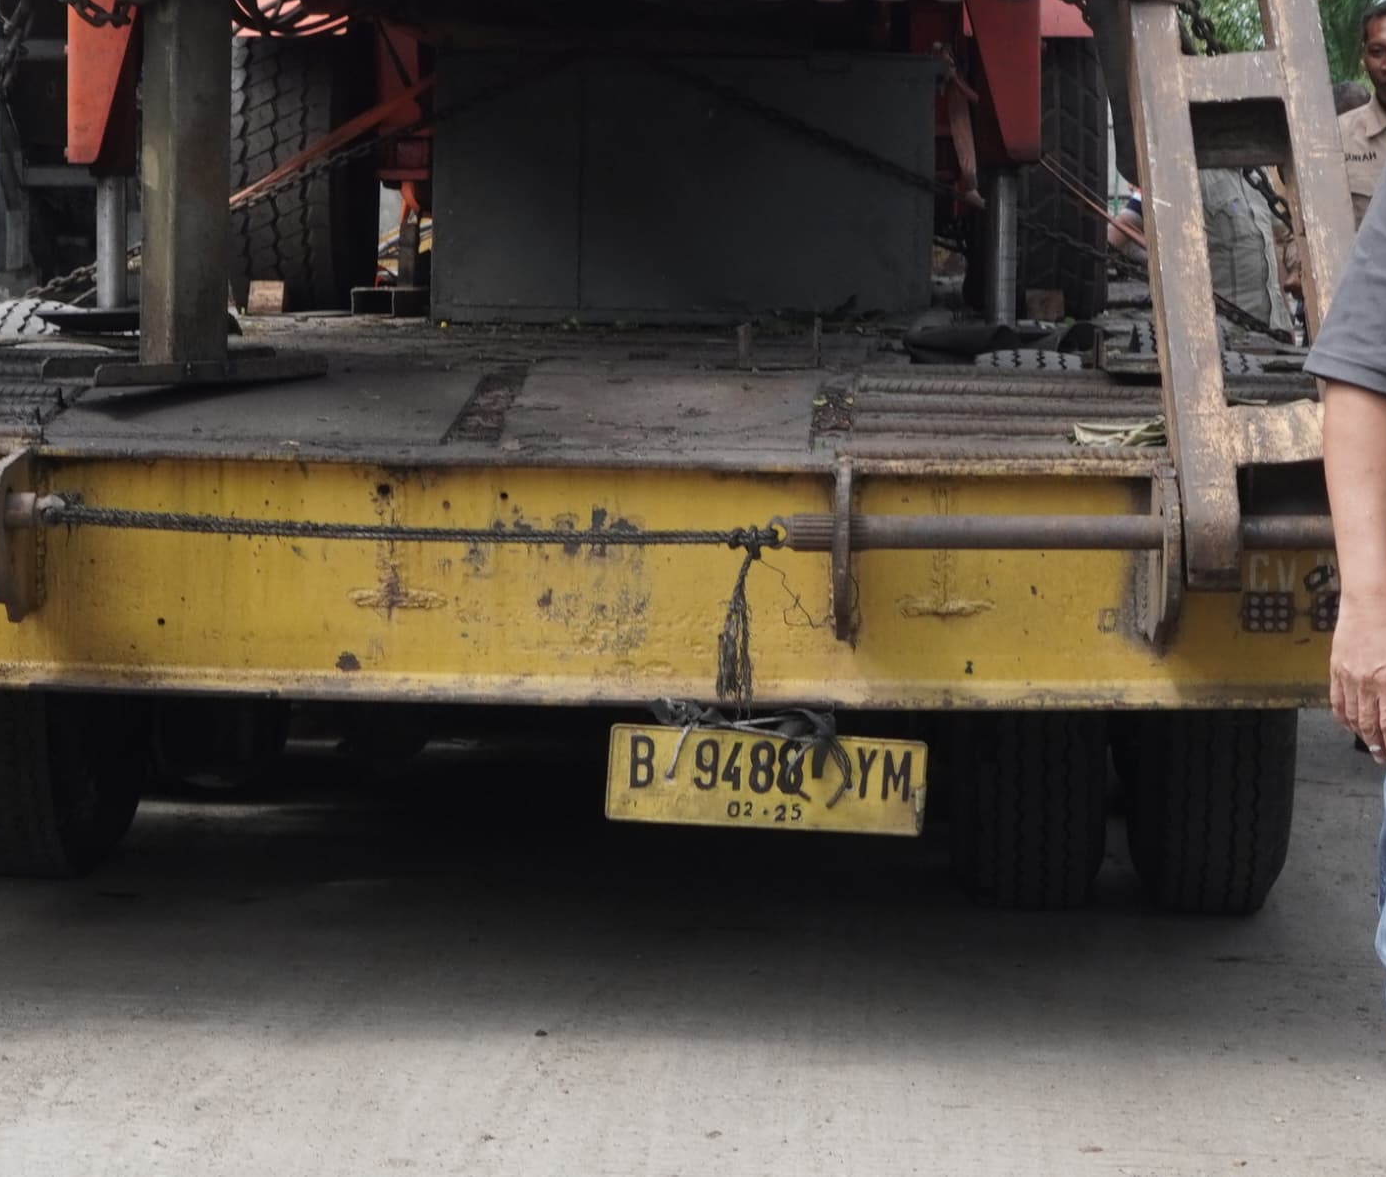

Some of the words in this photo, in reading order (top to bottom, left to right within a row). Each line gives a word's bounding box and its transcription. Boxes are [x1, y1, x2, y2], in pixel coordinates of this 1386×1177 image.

[629, 734, 655, 790] B
[693, 737, 805, 795] 9488
[857, 746, 913, 803] YM
